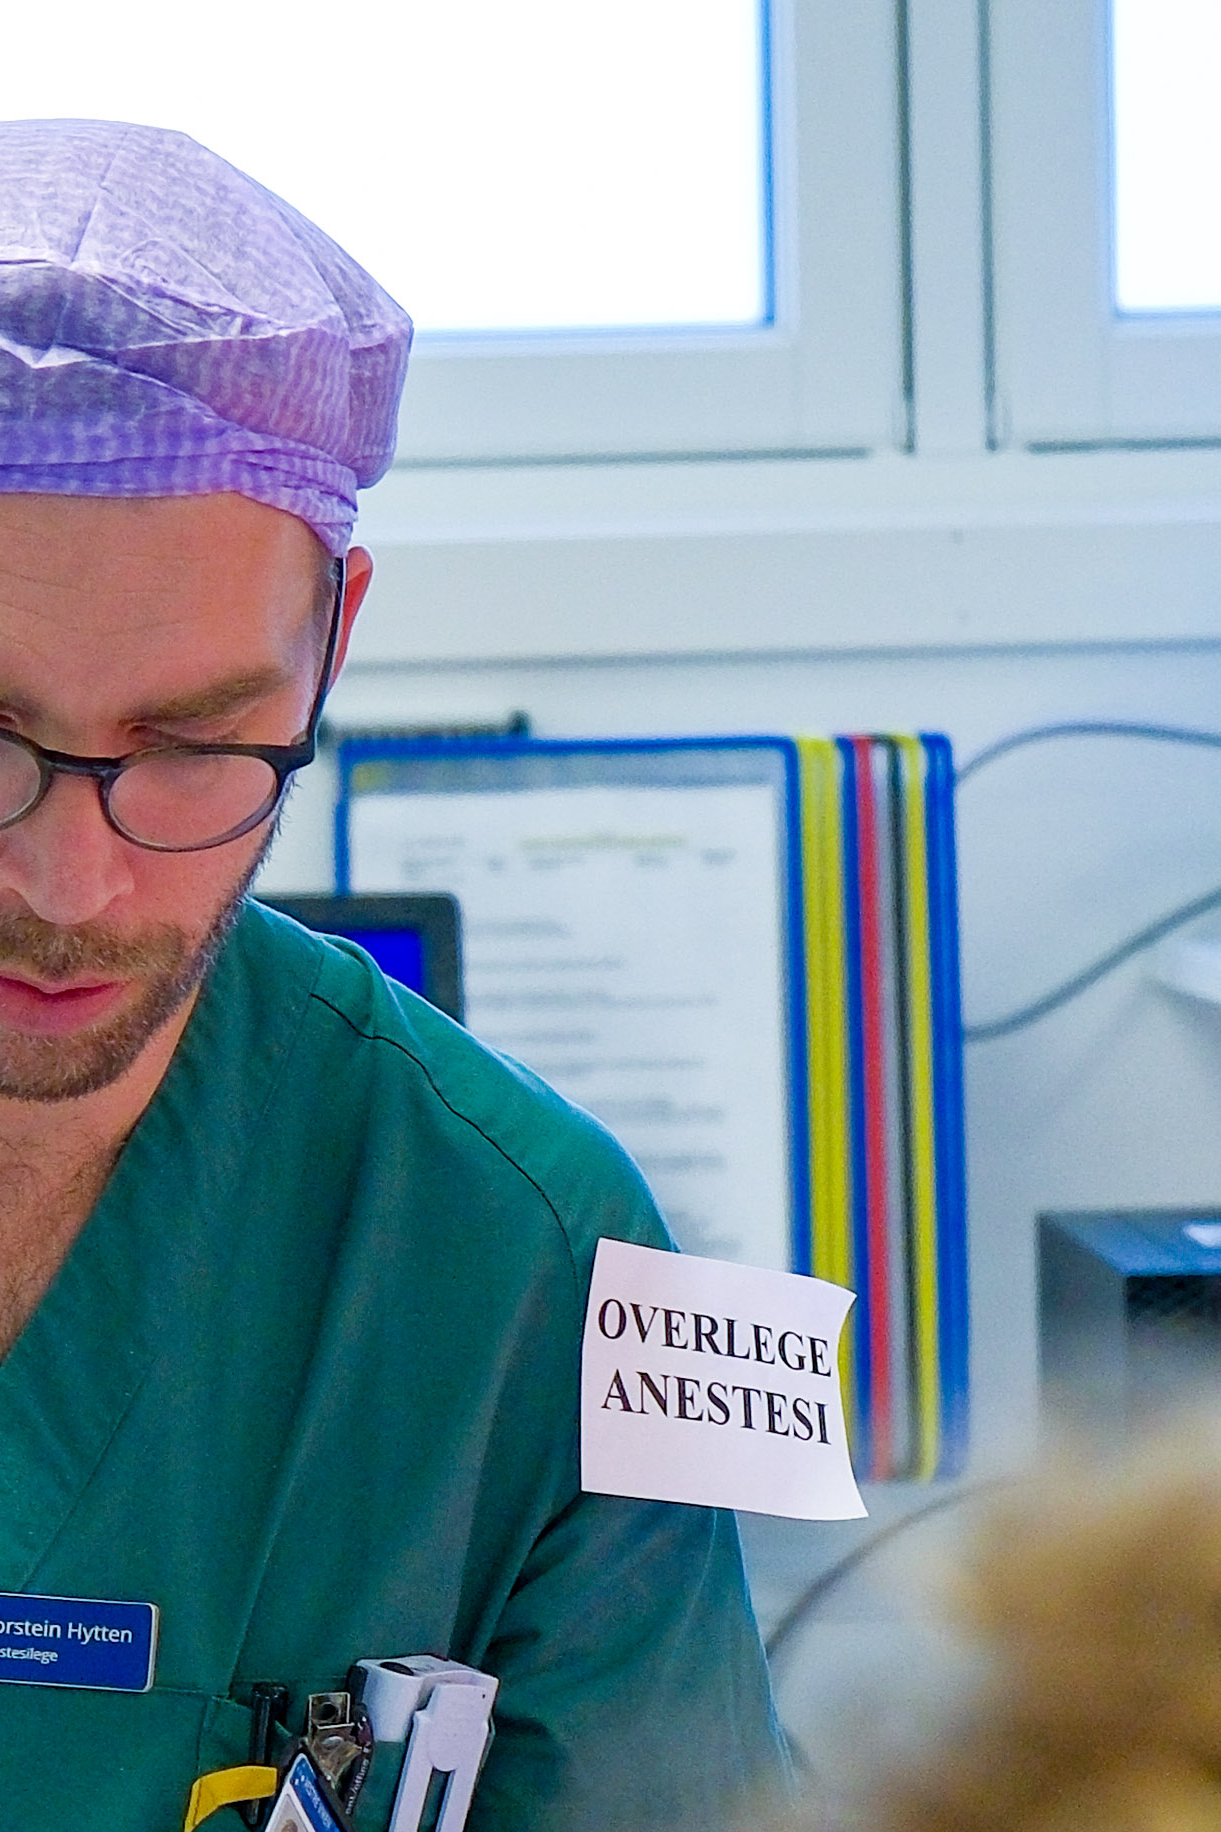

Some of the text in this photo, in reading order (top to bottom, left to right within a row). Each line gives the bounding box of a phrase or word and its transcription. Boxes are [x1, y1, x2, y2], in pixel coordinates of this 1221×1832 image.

[598, 1299, 832, 1377] OVERLEGE
[601, 1368, 832, 1445] ANESTESI
[67, 1622, 133, 1645] Hytten
